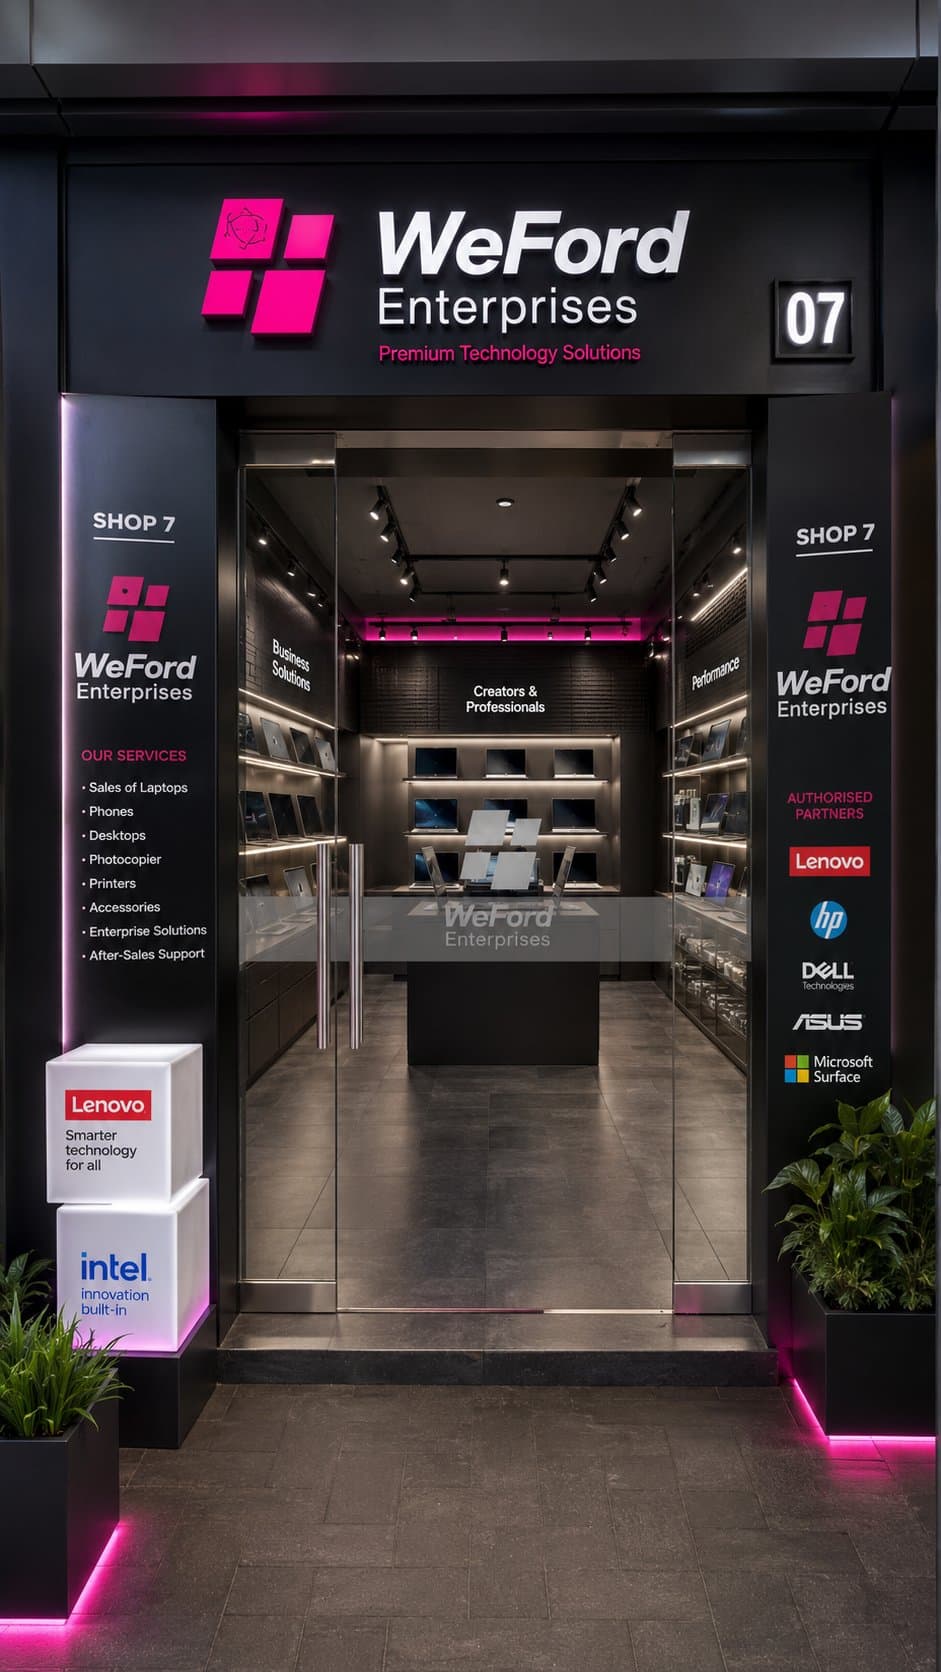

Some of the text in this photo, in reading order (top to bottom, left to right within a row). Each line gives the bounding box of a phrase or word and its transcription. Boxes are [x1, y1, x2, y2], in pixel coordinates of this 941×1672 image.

[379, 210, 690, 275] WeFord
[379, 287, 638, 333] Enterprises
[786, 292, 845, 345] 07
[379, 344, 641, 364] Premium Technology Solutions
[93, 512, 176, 532] SHOP 7
[796, 523, 875, 545] SHOP 7
[272, 638, 310, 672] Business
[74, 652, 197, 679] WeFord
[272, 659, 311, 692] Solutions
[692, 656, 740, 691] Performance
[777, 666, 893, 696] WeFord
[77, 682, 193, 703] Enterprises
[473, 685, 538, 698] Creators &
[466, 701, 546, 714] Professionals
[777, 698, 888, 719] Enterprises
[81, 750, 188, 762] OUR SERVICES
[89, 782, 188, 795] Sales of Laptops
[788, 792, 873, 804] AUTHORISED
[89, 806, 134, 817] Phones
[795, 808, 864, 820] PARTNERS
[89, 830, 146, 842] Desktops
[89, 854, 162, 867] Photocopier
[796, 853, 864, 869] Lenovo
[89, 878, 136, 889] Printers
[89, 901, 161, 913] Accessories
[445, 902, 554, 928] WeFord
[814, 901, 844, 939] hp
[89, 925, 207, 939] Enterprise Solutions
[445, 931, 551, 950] Enterprises
[89, 948, 205, 961] After-Sales Support
[802, 961, 854, 980] DELL
[802, 981, 855, 991] Technologies
[792, 1013, 863, 1031] ASUS
[813, 1055, 873, 1068] Microsoft
[814, 1070, 861, 1083] Surface
[72, 1096, 145, 1113] Lenovo
[65, 1129, 117, 1141] Smarter
[65, 1145, 137, 1159] technology
[66, 1159, 101, 1171] for all
[81, 1287, 149, 1301] innovation
